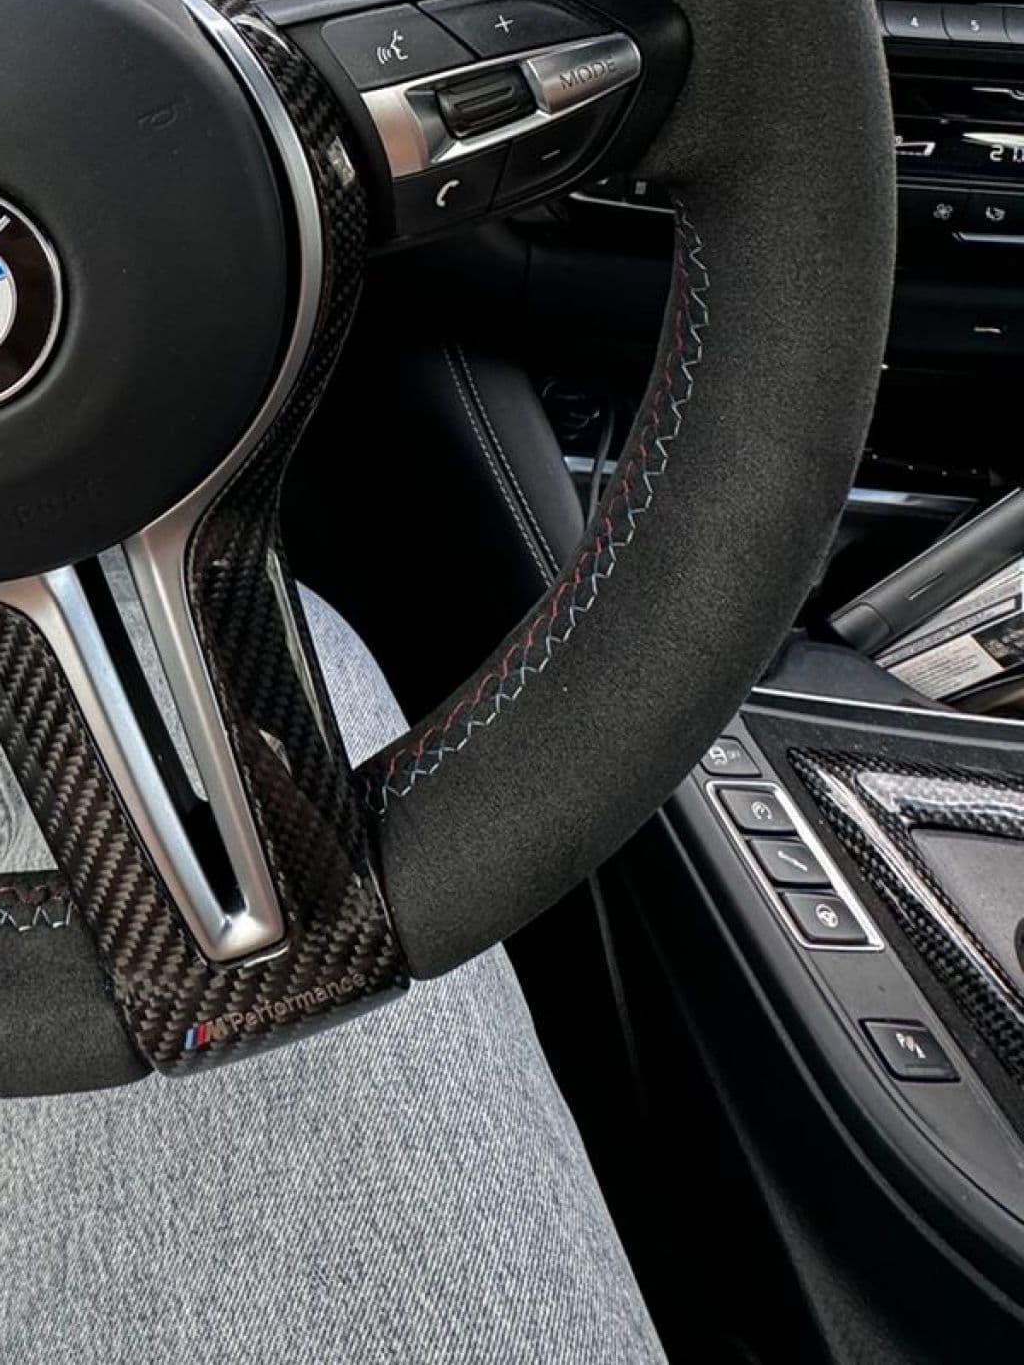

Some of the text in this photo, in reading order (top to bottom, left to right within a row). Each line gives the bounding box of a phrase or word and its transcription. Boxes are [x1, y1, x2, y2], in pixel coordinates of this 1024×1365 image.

[910, 15, 919, 27] 4
[970, 19, 980, 31] 5
[559, 55, 617, 91] MODE
[229, 972, 367, 1034] Performance
